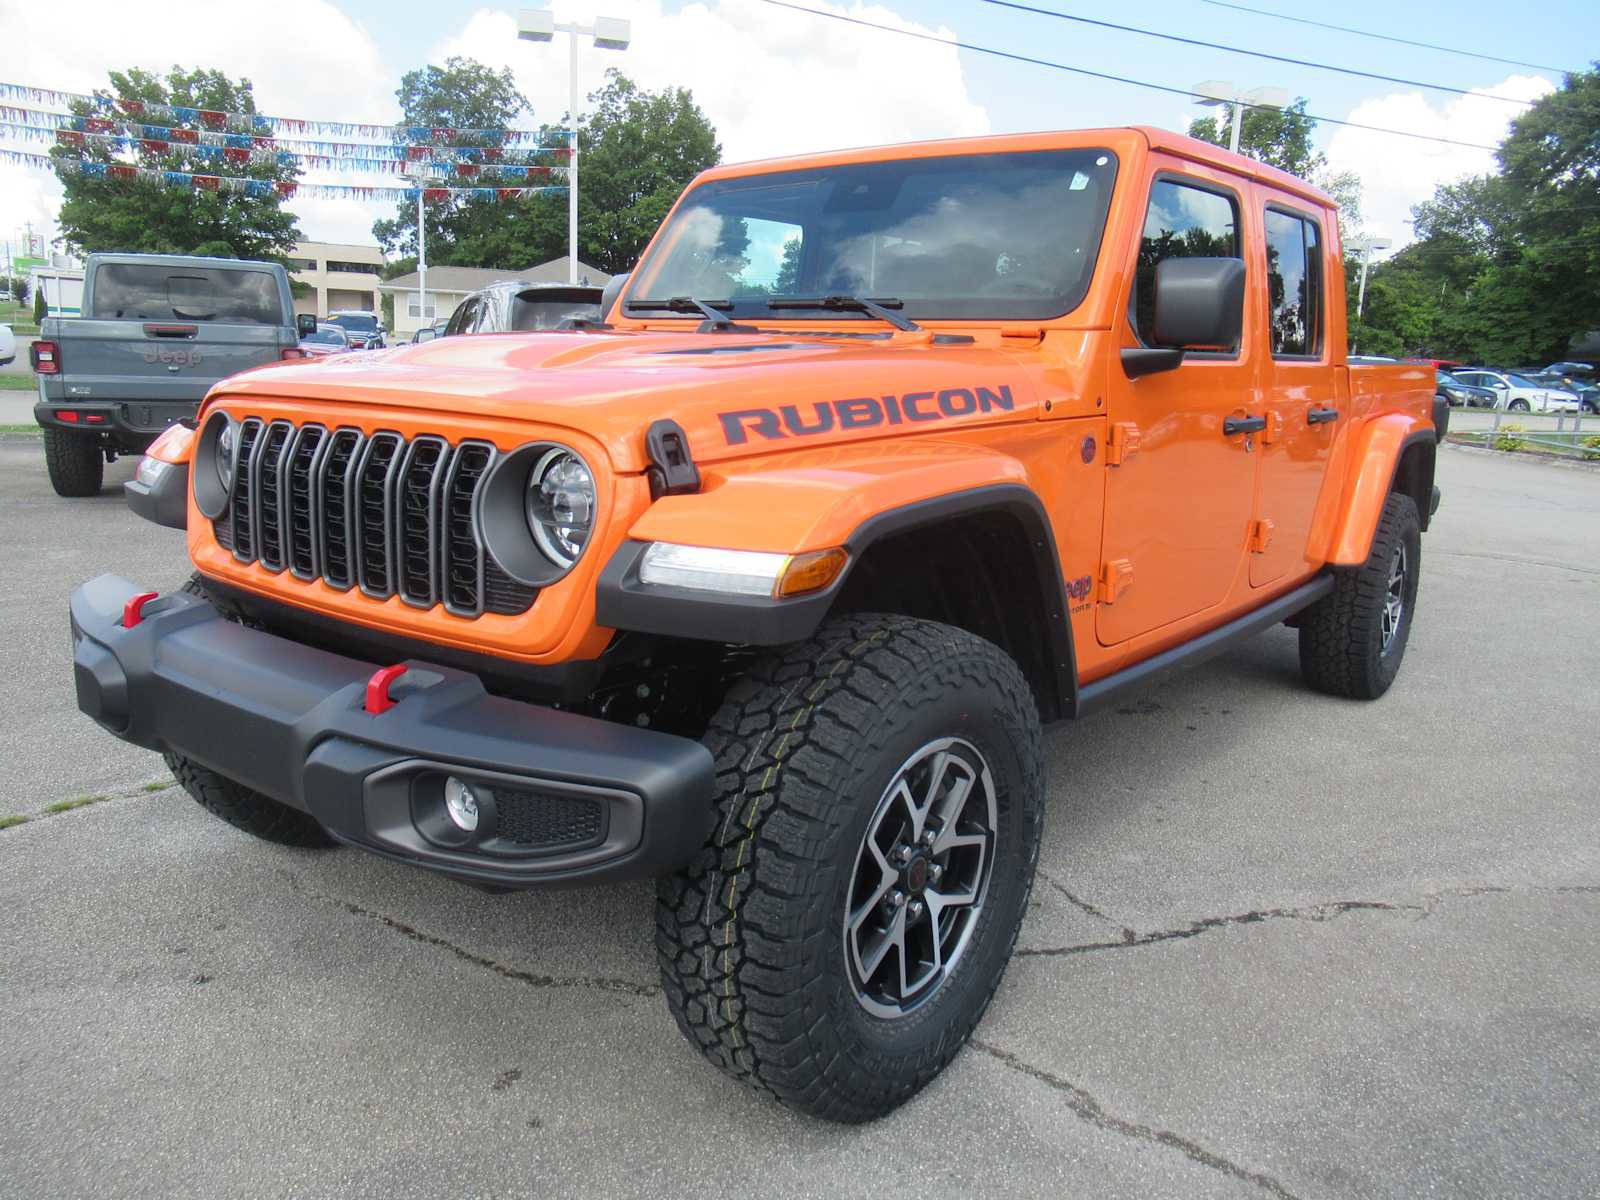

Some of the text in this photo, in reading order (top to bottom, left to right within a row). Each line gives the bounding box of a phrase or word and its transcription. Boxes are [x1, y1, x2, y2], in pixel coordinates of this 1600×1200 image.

[144, 346, 201, 367] Jeep
[717, 385, 1014, 446] RUBICON
[1064, 575, 1092, 601] eep
